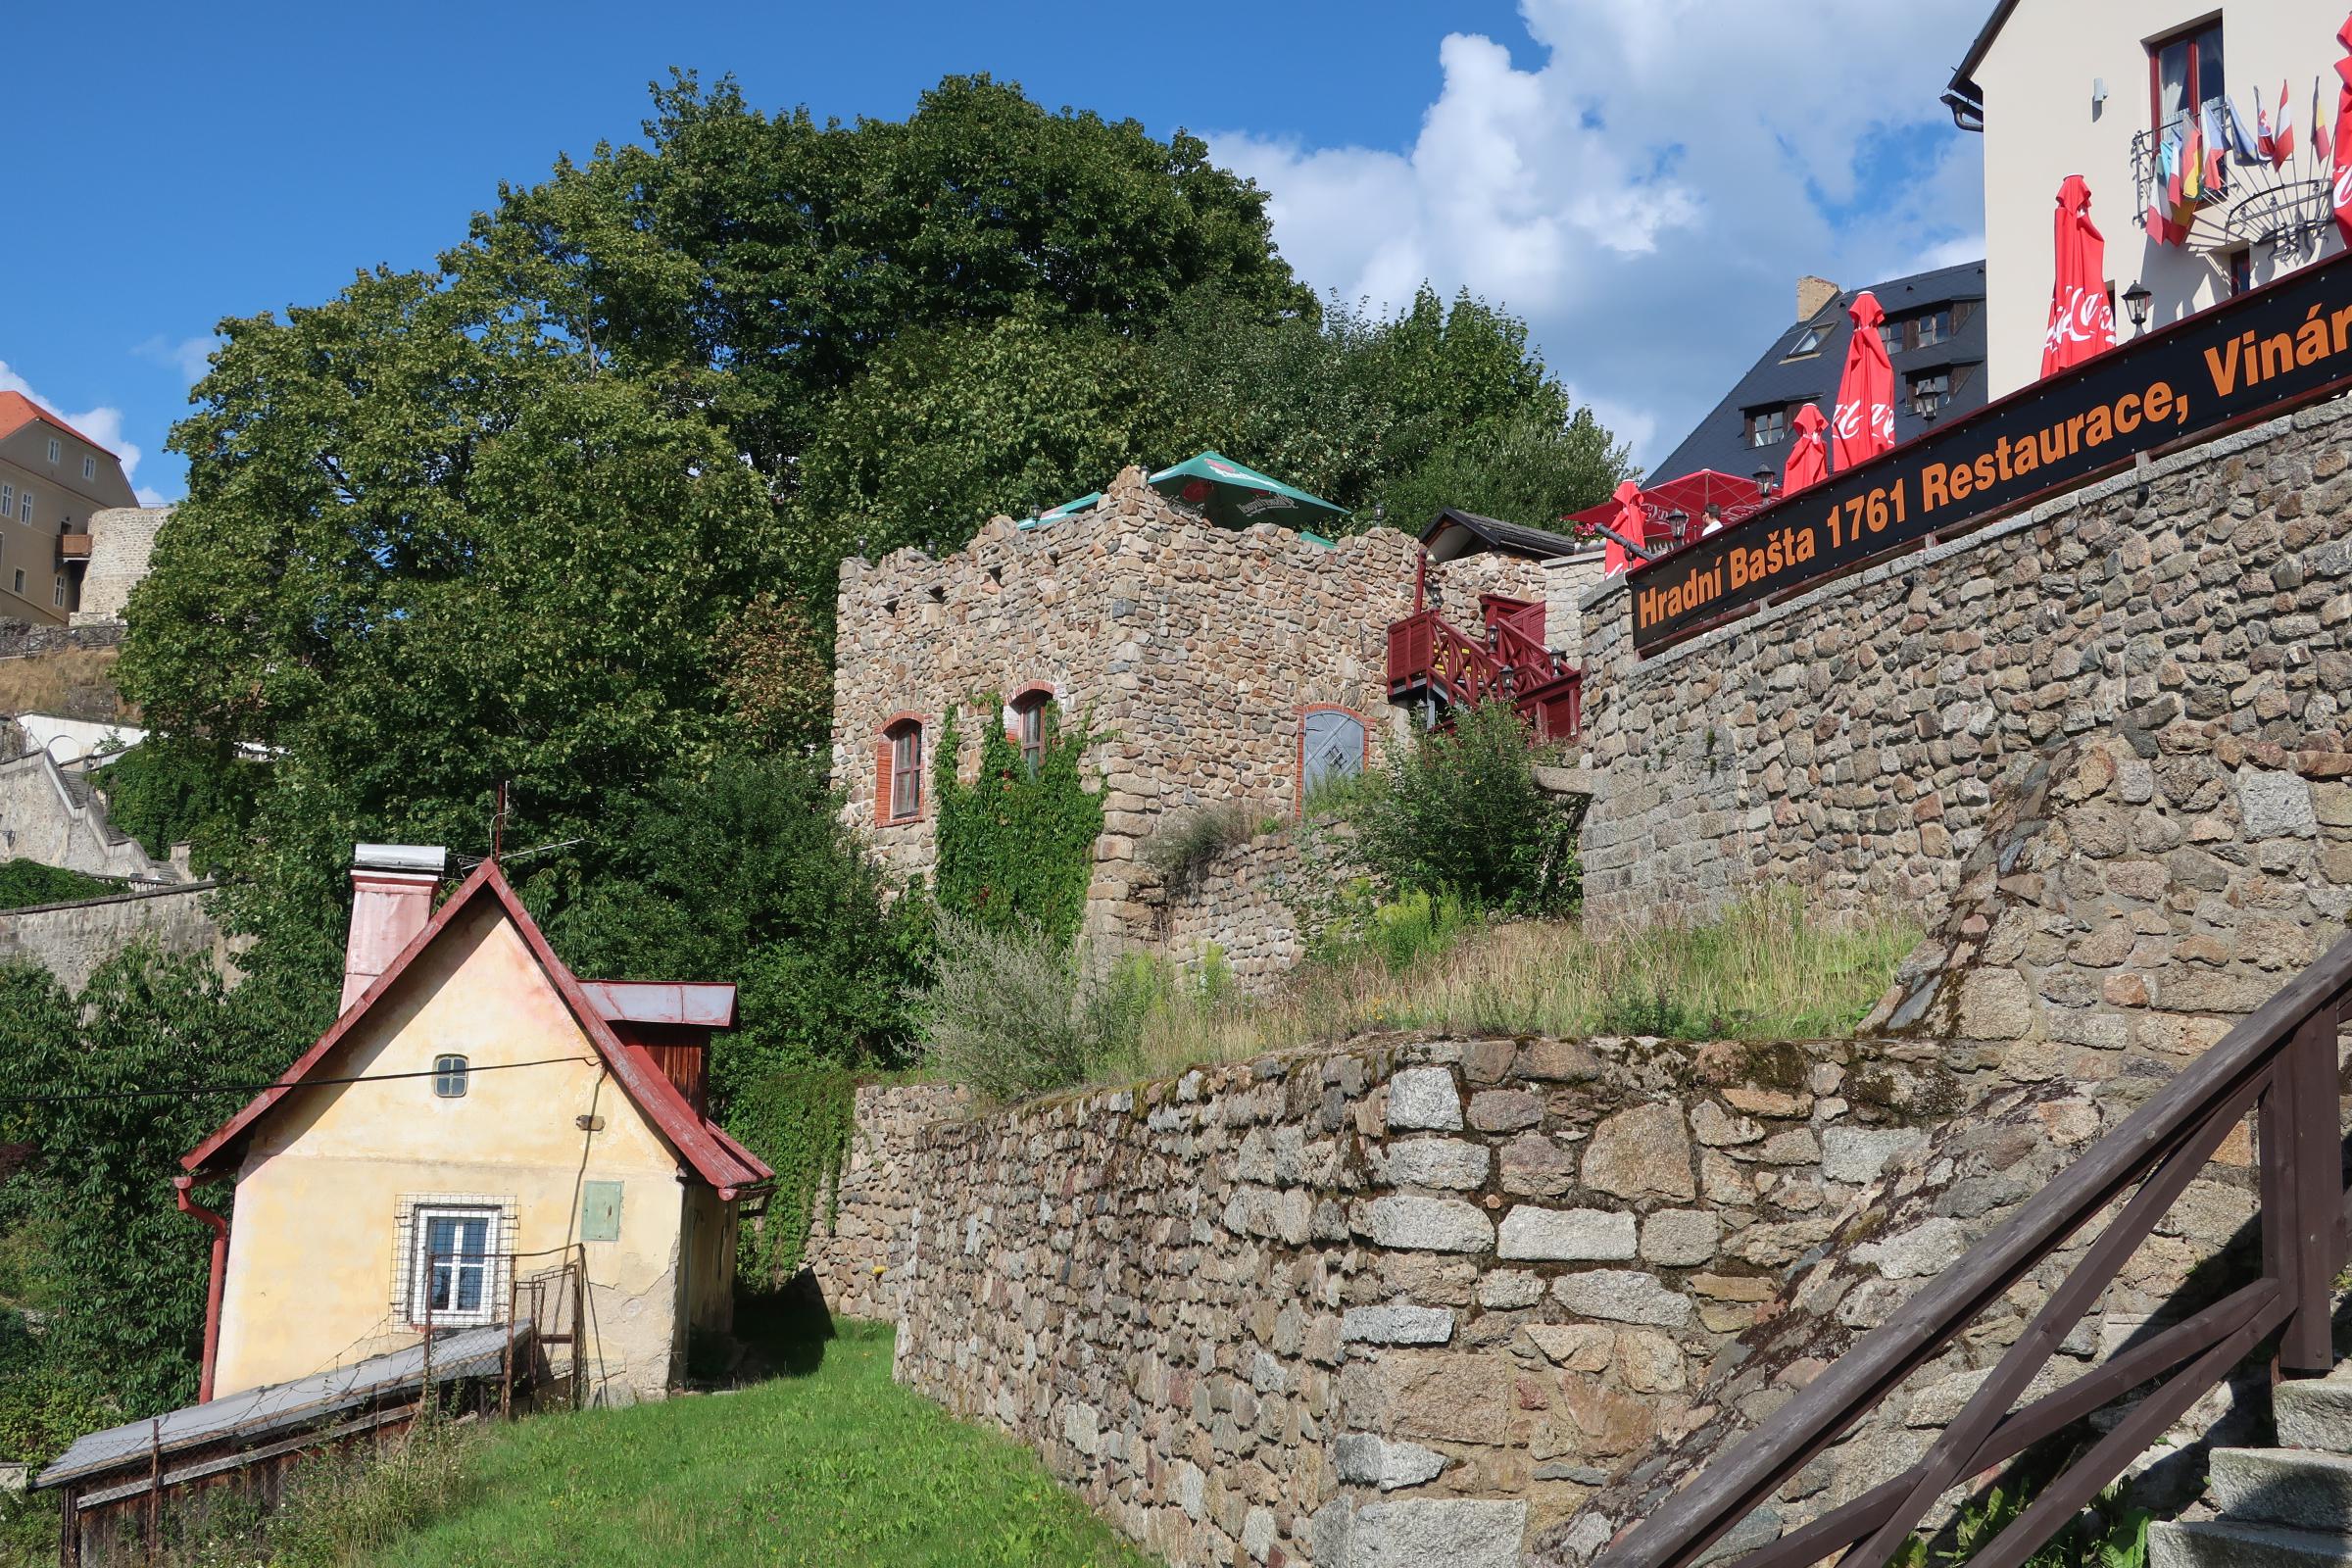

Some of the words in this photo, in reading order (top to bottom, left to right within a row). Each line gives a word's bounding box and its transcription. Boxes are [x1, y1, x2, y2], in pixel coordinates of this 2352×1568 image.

[1640, 556, 1722, 629] Hradní
[1730, 527, 1816, 591] Bašta
[1827, 478, 1906, 549] 1761
[1922, 381, 2188, 513] Restaurace,
[2204, 303, 2352, 397] Vinár
